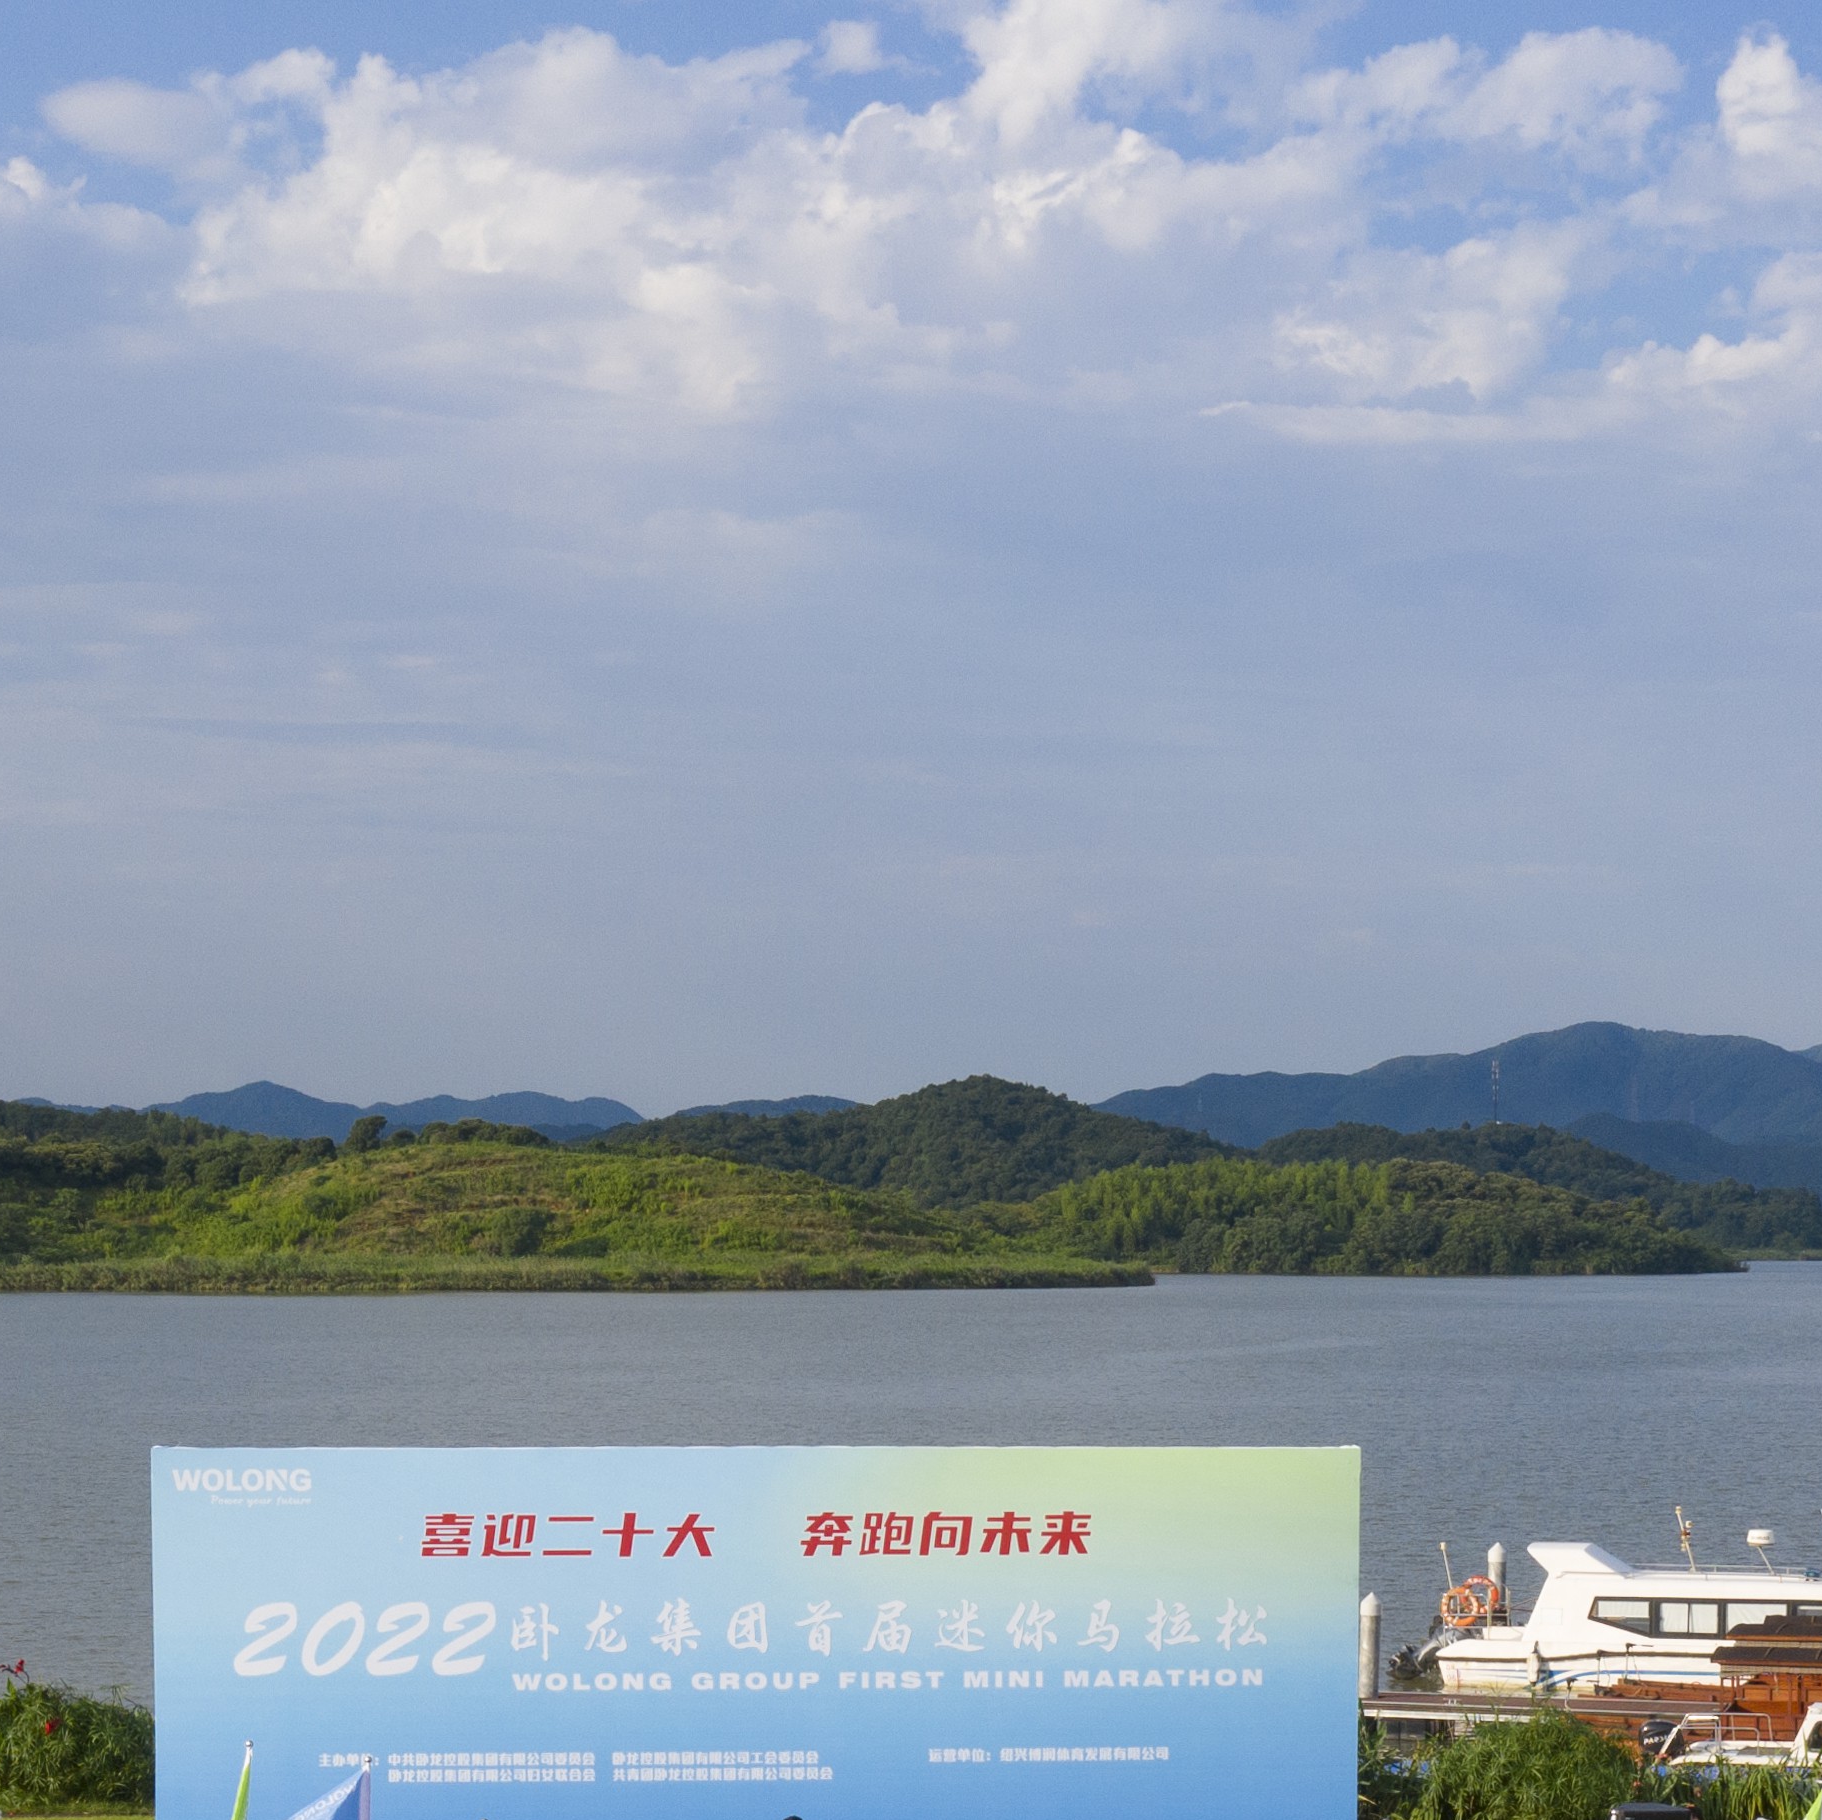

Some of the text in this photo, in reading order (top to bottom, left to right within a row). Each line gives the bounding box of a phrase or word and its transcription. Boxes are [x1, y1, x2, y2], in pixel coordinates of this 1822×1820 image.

[172, 1468, 313, 1492] WOLONG
[419, 1511, 1093, 1558] 喜迎二十大 奔跑向未来
[232, 1597, 1269, 1677] 2022 卧龙集团首届迷你马拉松
[512, 1667, 1265, 1692] WOLONG GROUP FIRST MINI MARATHON
[387, 1752, 596, 1766] 中共卧龙控股集团有限公司委员会
[611, 1751, 819, 1765] 卧龙控股集团有限公司工会委员会
[387, 1767, 834, 1782] 卧龙控股集团有限公司妇女联合会 共青团卧龙控股集团有限公司委员会
